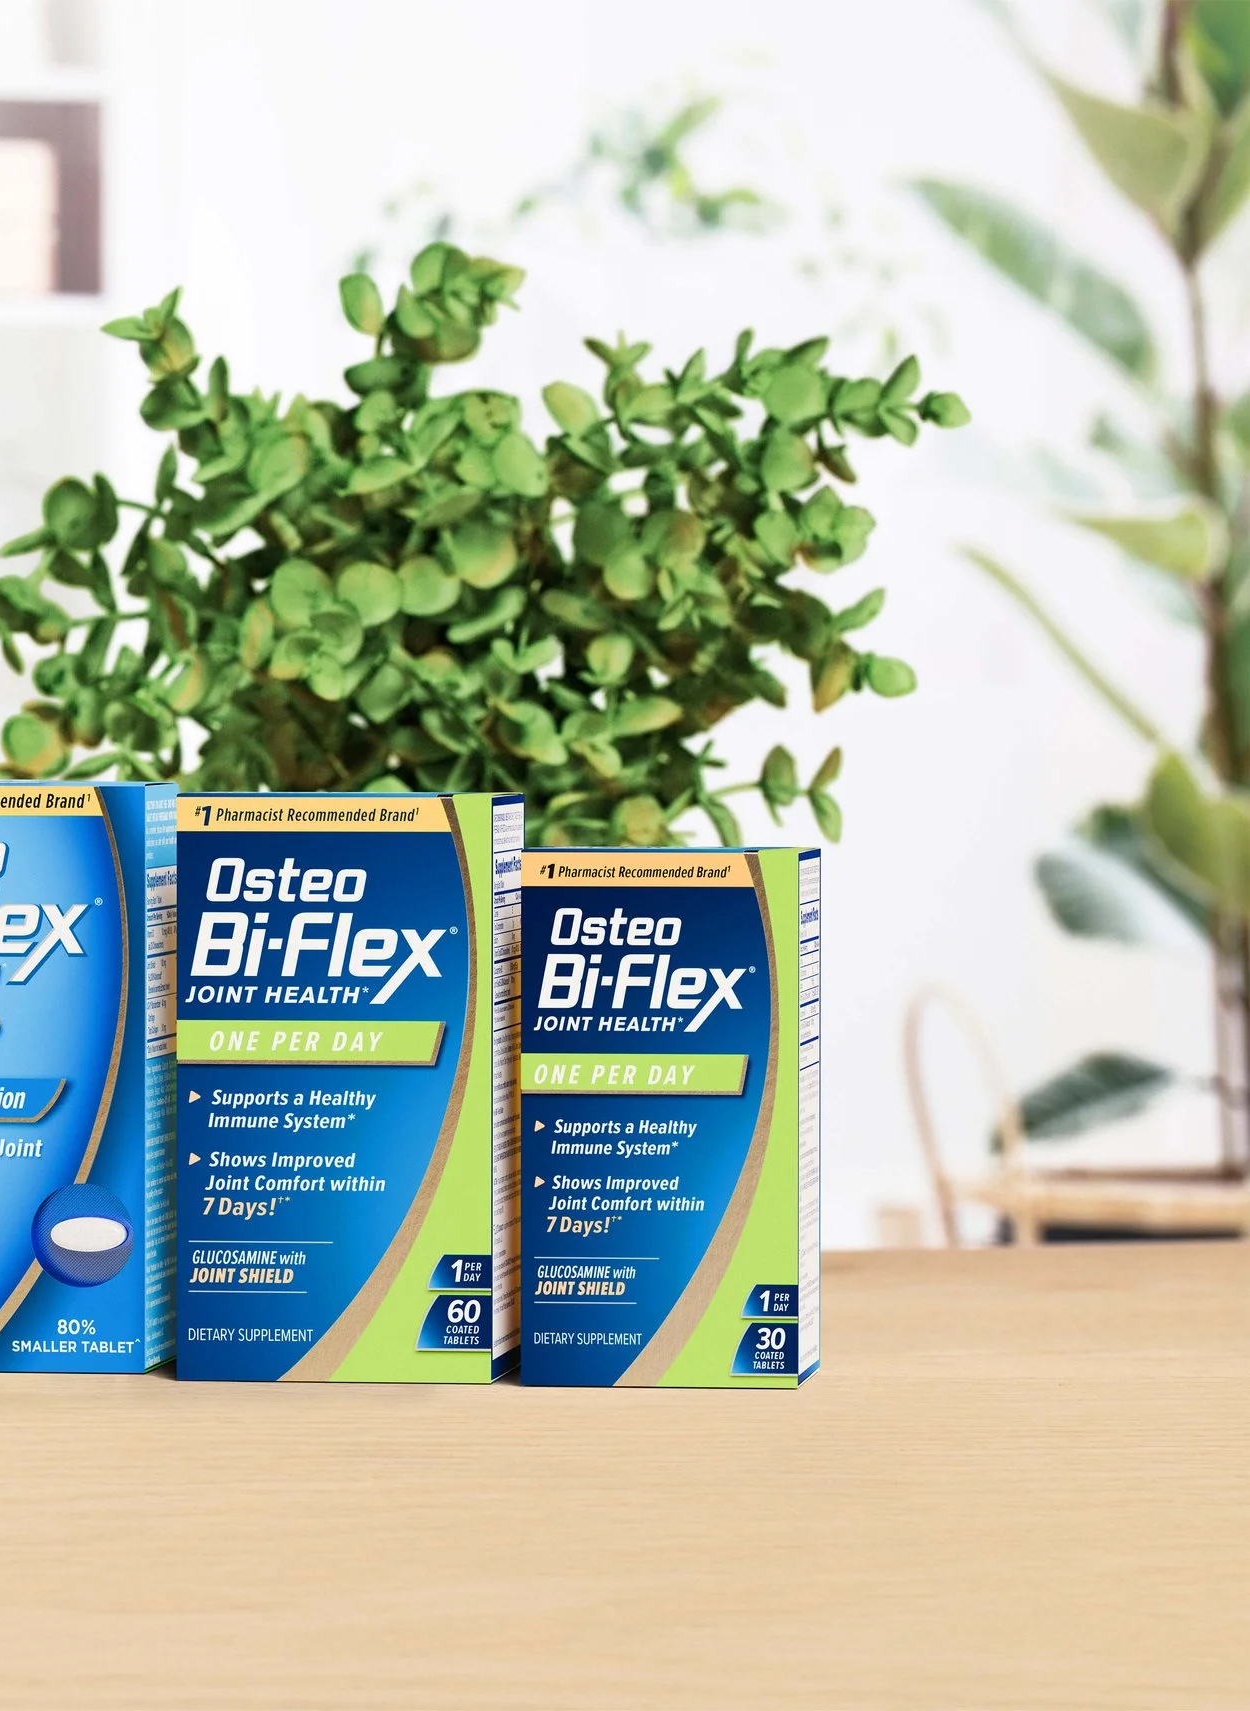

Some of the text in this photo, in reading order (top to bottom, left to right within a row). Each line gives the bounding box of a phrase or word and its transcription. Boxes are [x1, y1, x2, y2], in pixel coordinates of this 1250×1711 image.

[194, 805, 212, 826] #1
[216, 808, 283, 822] Pharmacist
[287, 808, 376, 822] Recommended
[206, 857, 367, 902] Osteo
[539, 863, 555, 879] #1
[558, 866, 616, 879] Pharmacist
[618, 866, 694, 879] Recommended
[550, 907, 682, 946] Osteo
[185, 985, 258, 1004] JOINT
[533, 1016, 593, 1032] JOINT
[209, 1030, 384, 1052] ONE PER DAY
[533, 1063, 696, 1085] ONE PER DAY
[211, 1089, 376, 1110] Supports a Healthy
[208, 1112, 279, 1129] Immune
[554, 1119, 697, 1137] Supports a Healthy
[551, 1140, 612, 1155] Immune
[209, 1151, 356, 1171] Shows Improved
[205, 1174, 386, 1192] Joint Comfort within
[552, 1175, 679, 1193] Shows Improved
[202, 1196, 215, 1216] 7
[548, 1196, 705, 1212] Joint Comfort within
[546, 1216, 557, 1233] 7
[192, 1249, 306, 1265] GLUCOSAMINE with
[189, 1267, 236, 1284] JOINT
[238, 1267, 294, 1284] SHIELD
[451, 1259, 482, 1282] 1 PER
[463, 1273, 481, 1282] DAY
[537, 1265, 636, 1279] GLUCOSAMINE with
[534, 1281, 626, 1296] JOINT SHIELD
[759, 1290, 790, 1312] 1 PER
[773, 1303, 789, 1312] DAY
[447, 1299, 481, 1324] 60
[57, 1319, 96, 1336] 80%
[188, 1327, 314, 1343] DIETARY SUPPLEMENT
[445, 1325, 480, 1334] COATED
[12, 1339, 77, 1353] SMALLER
[443, 1336, 480, 1345] TABLETS
[533, 1332, 575, 1345] DIETARY
[577, 1332, 643, 1346] SUPPLEMENT
[755, 1327, 786, 1350] 30
[754, 1351, 784, 1360] COATED
[752, 1361, 785, 1370] TABLETS
